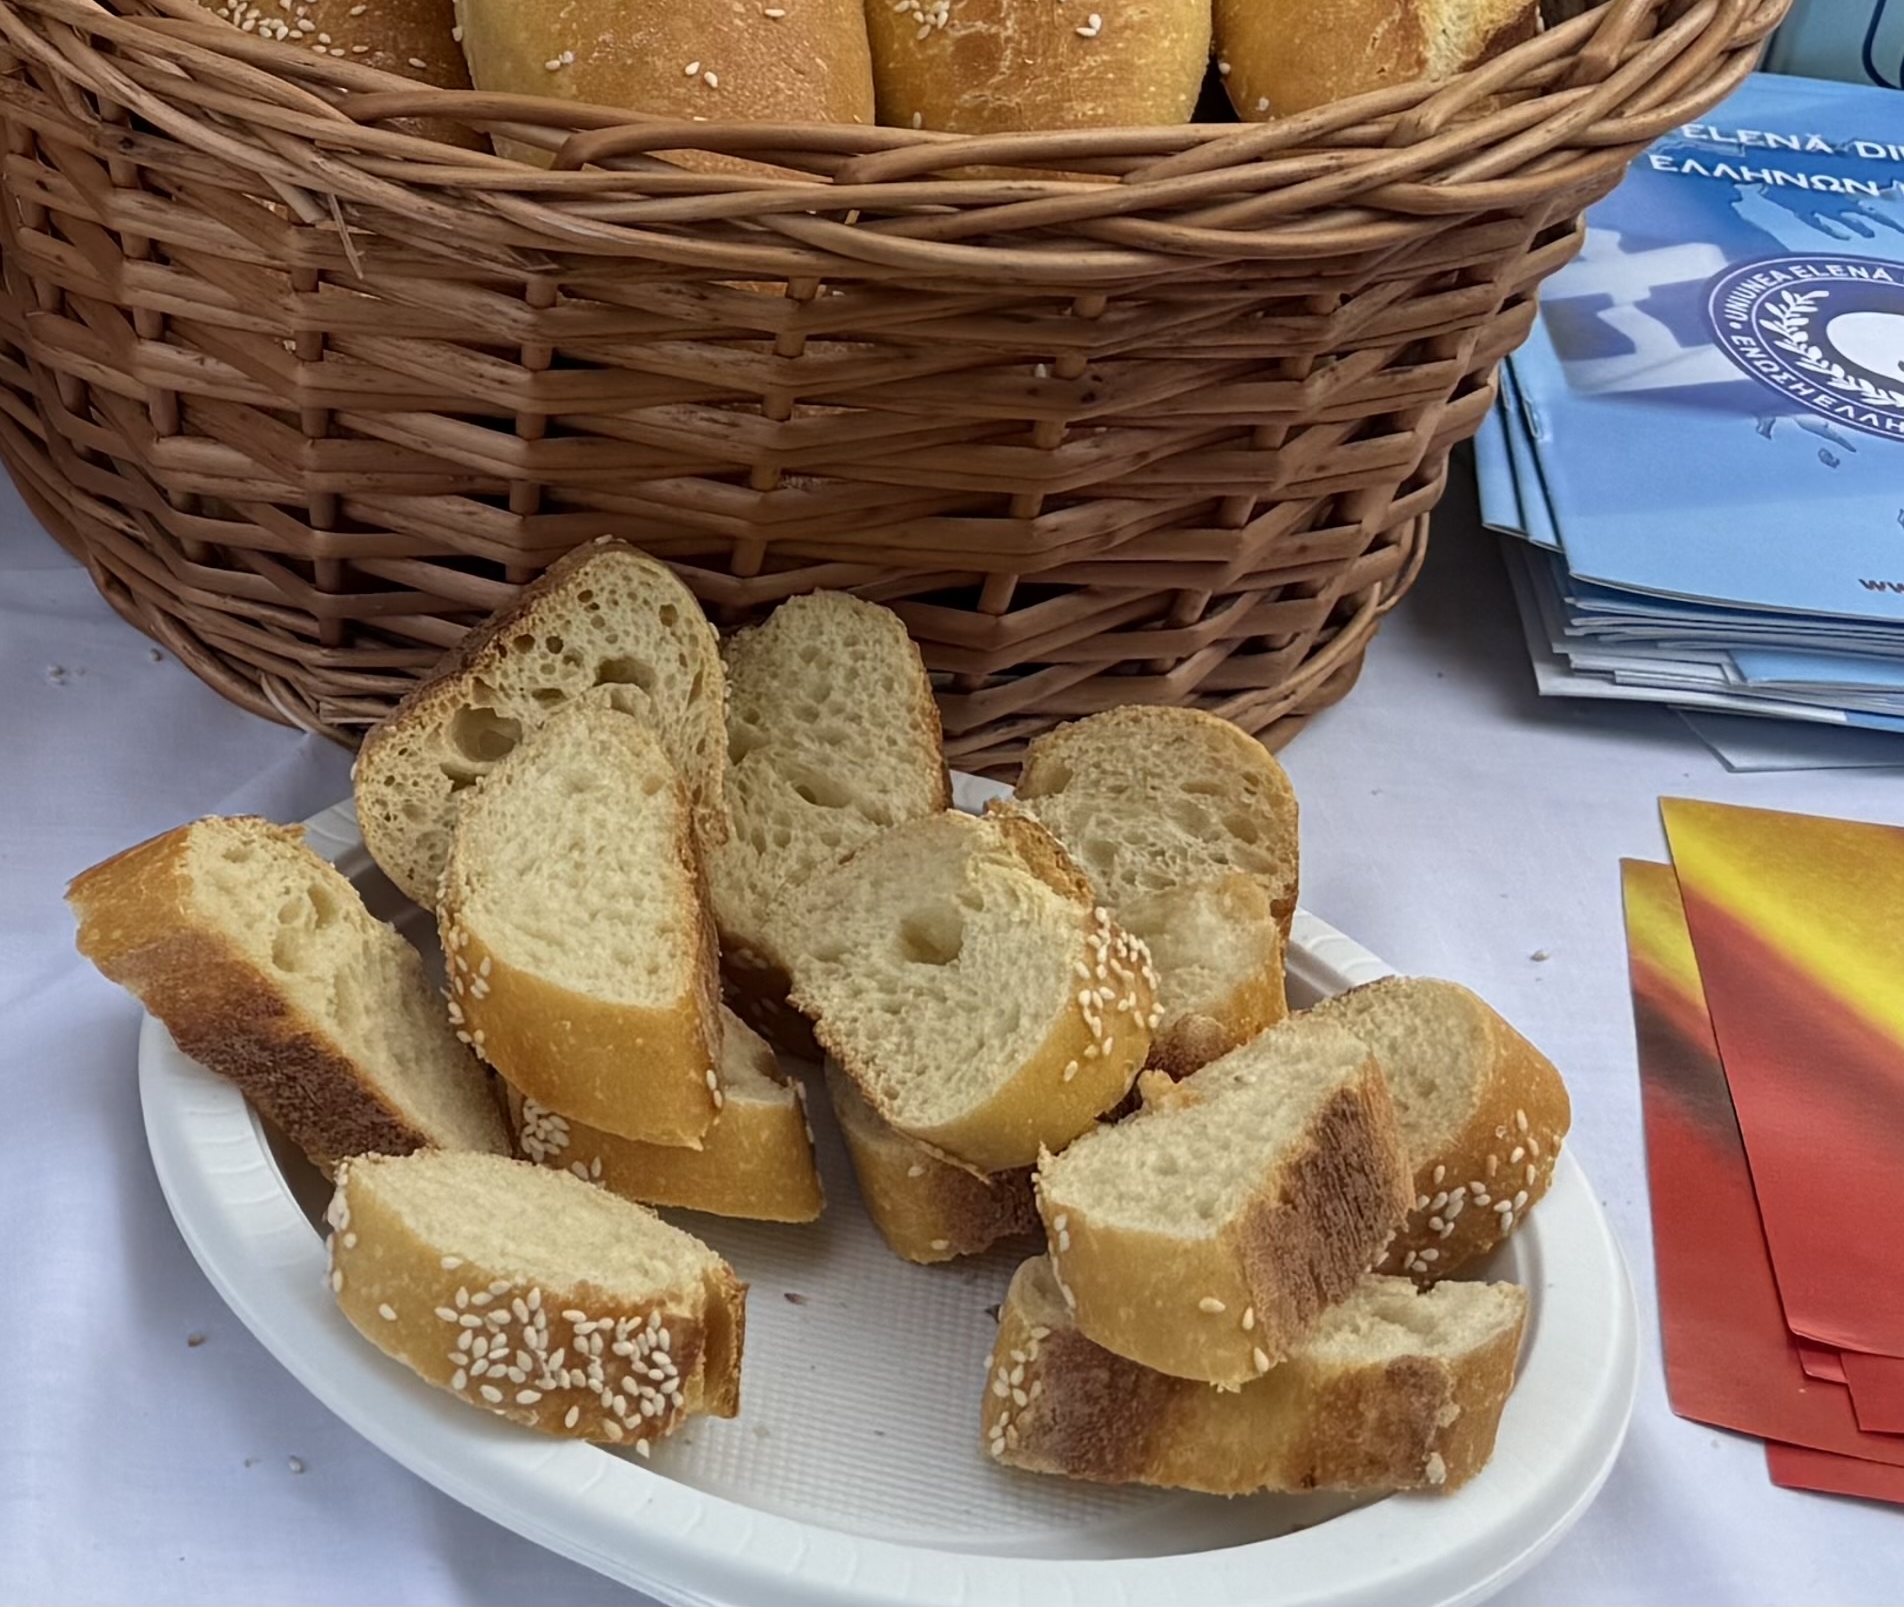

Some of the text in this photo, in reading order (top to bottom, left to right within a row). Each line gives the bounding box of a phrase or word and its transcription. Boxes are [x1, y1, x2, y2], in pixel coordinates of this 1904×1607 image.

[1648, 154, 1880, 197] ΕΛΛΗΝΩΝ
[1724, 270, 1792, 322] UNIUNEA
[1730, 335, 1816, 396] ΕΝΩΣΗ
